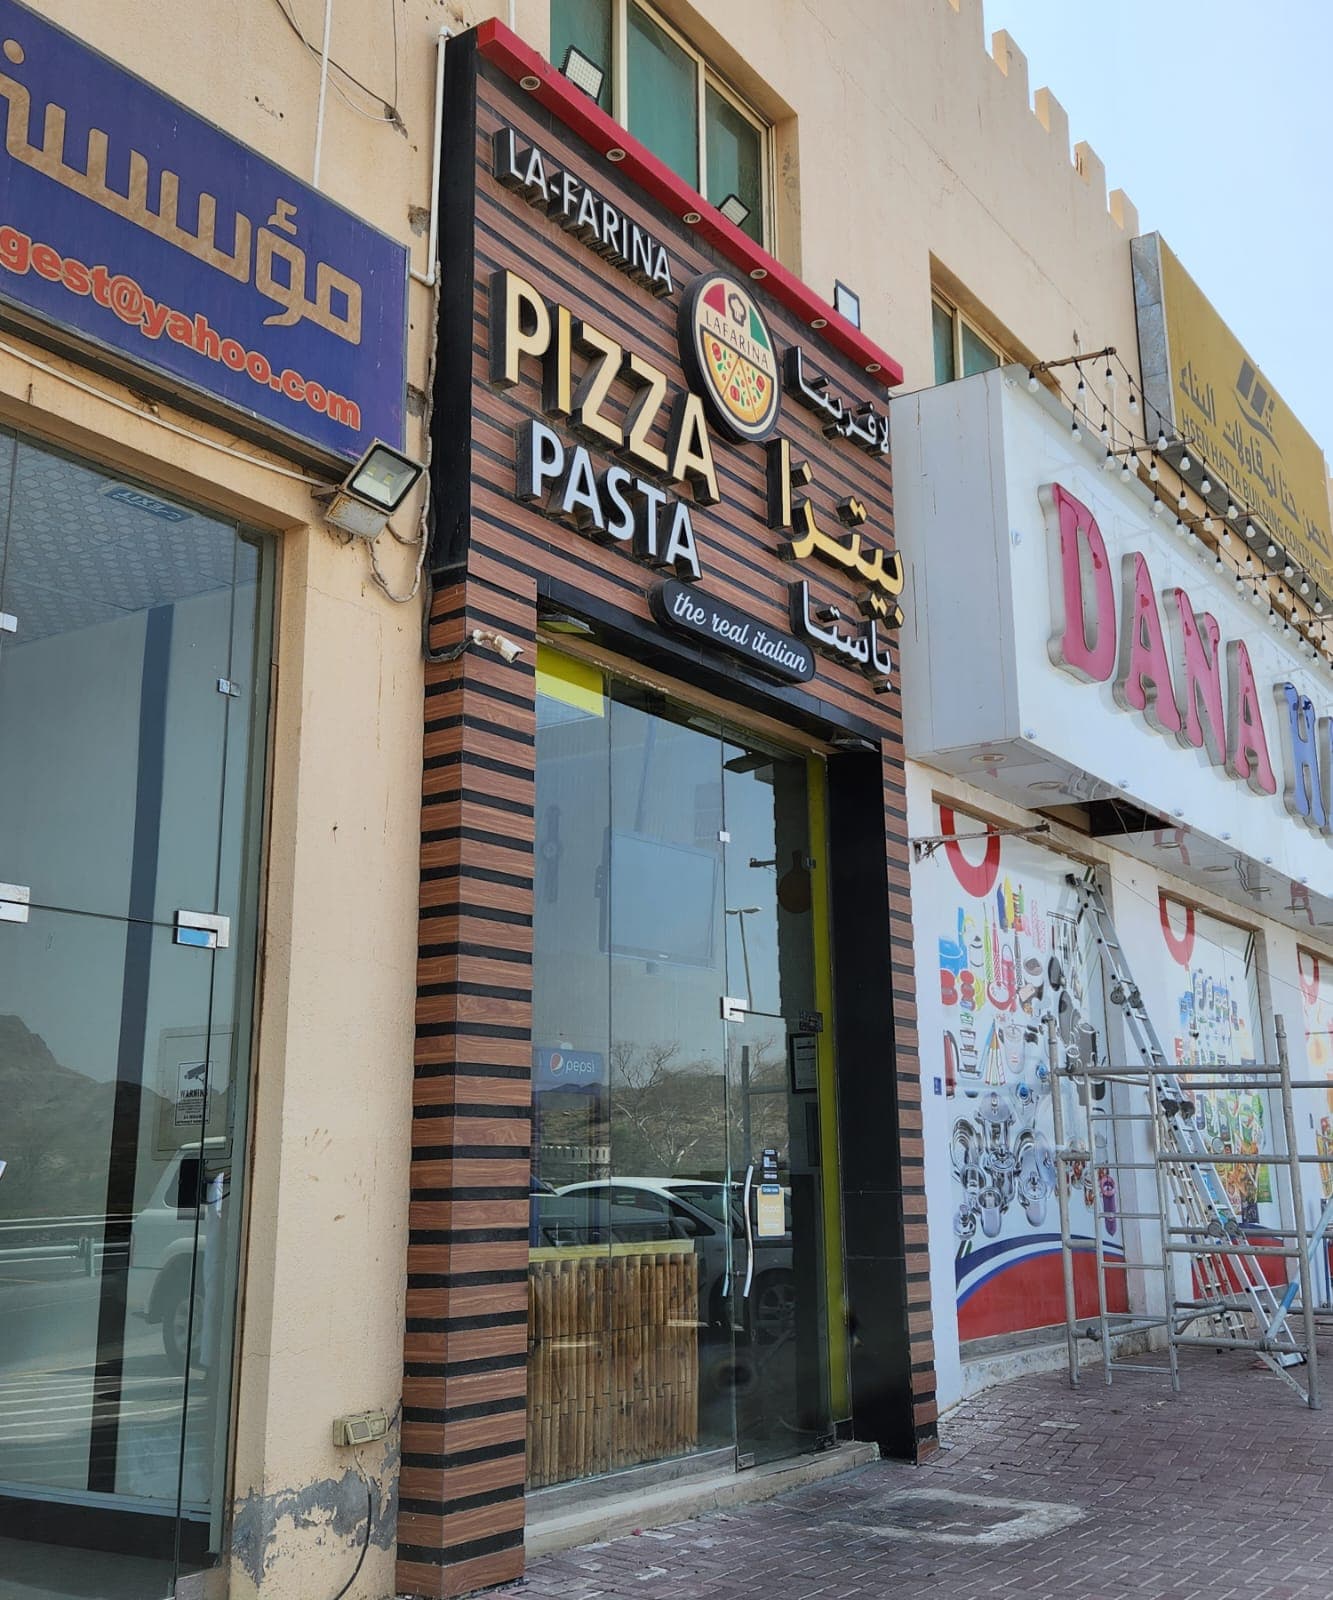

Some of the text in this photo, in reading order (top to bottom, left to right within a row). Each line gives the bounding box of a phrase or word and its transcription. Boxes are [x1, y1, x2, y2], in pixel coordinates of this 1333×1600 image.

[508, 128, 675, 294] LA-FARINA
[0, 226, 361, 431] gest@yahoo.com
[502, 269, 721, 503] PIZZA
[705, 310, 769, 370] LAFARINA
[1179, 361, 1216, 428] البناء
[532, 420, 702, 579] PASTA
[780, 440, 905, 625] بيتزا
[1210, 441, 1243, 496] HATTA
[1242, 476, 1284, 542] BUILDING
[673, 592, 807, 673] the real italian
[803, 580, 892, 692] باستا
[1040, 482, 1333, 838] DANA H
[565, 1060, 595, 1075] pepsi
